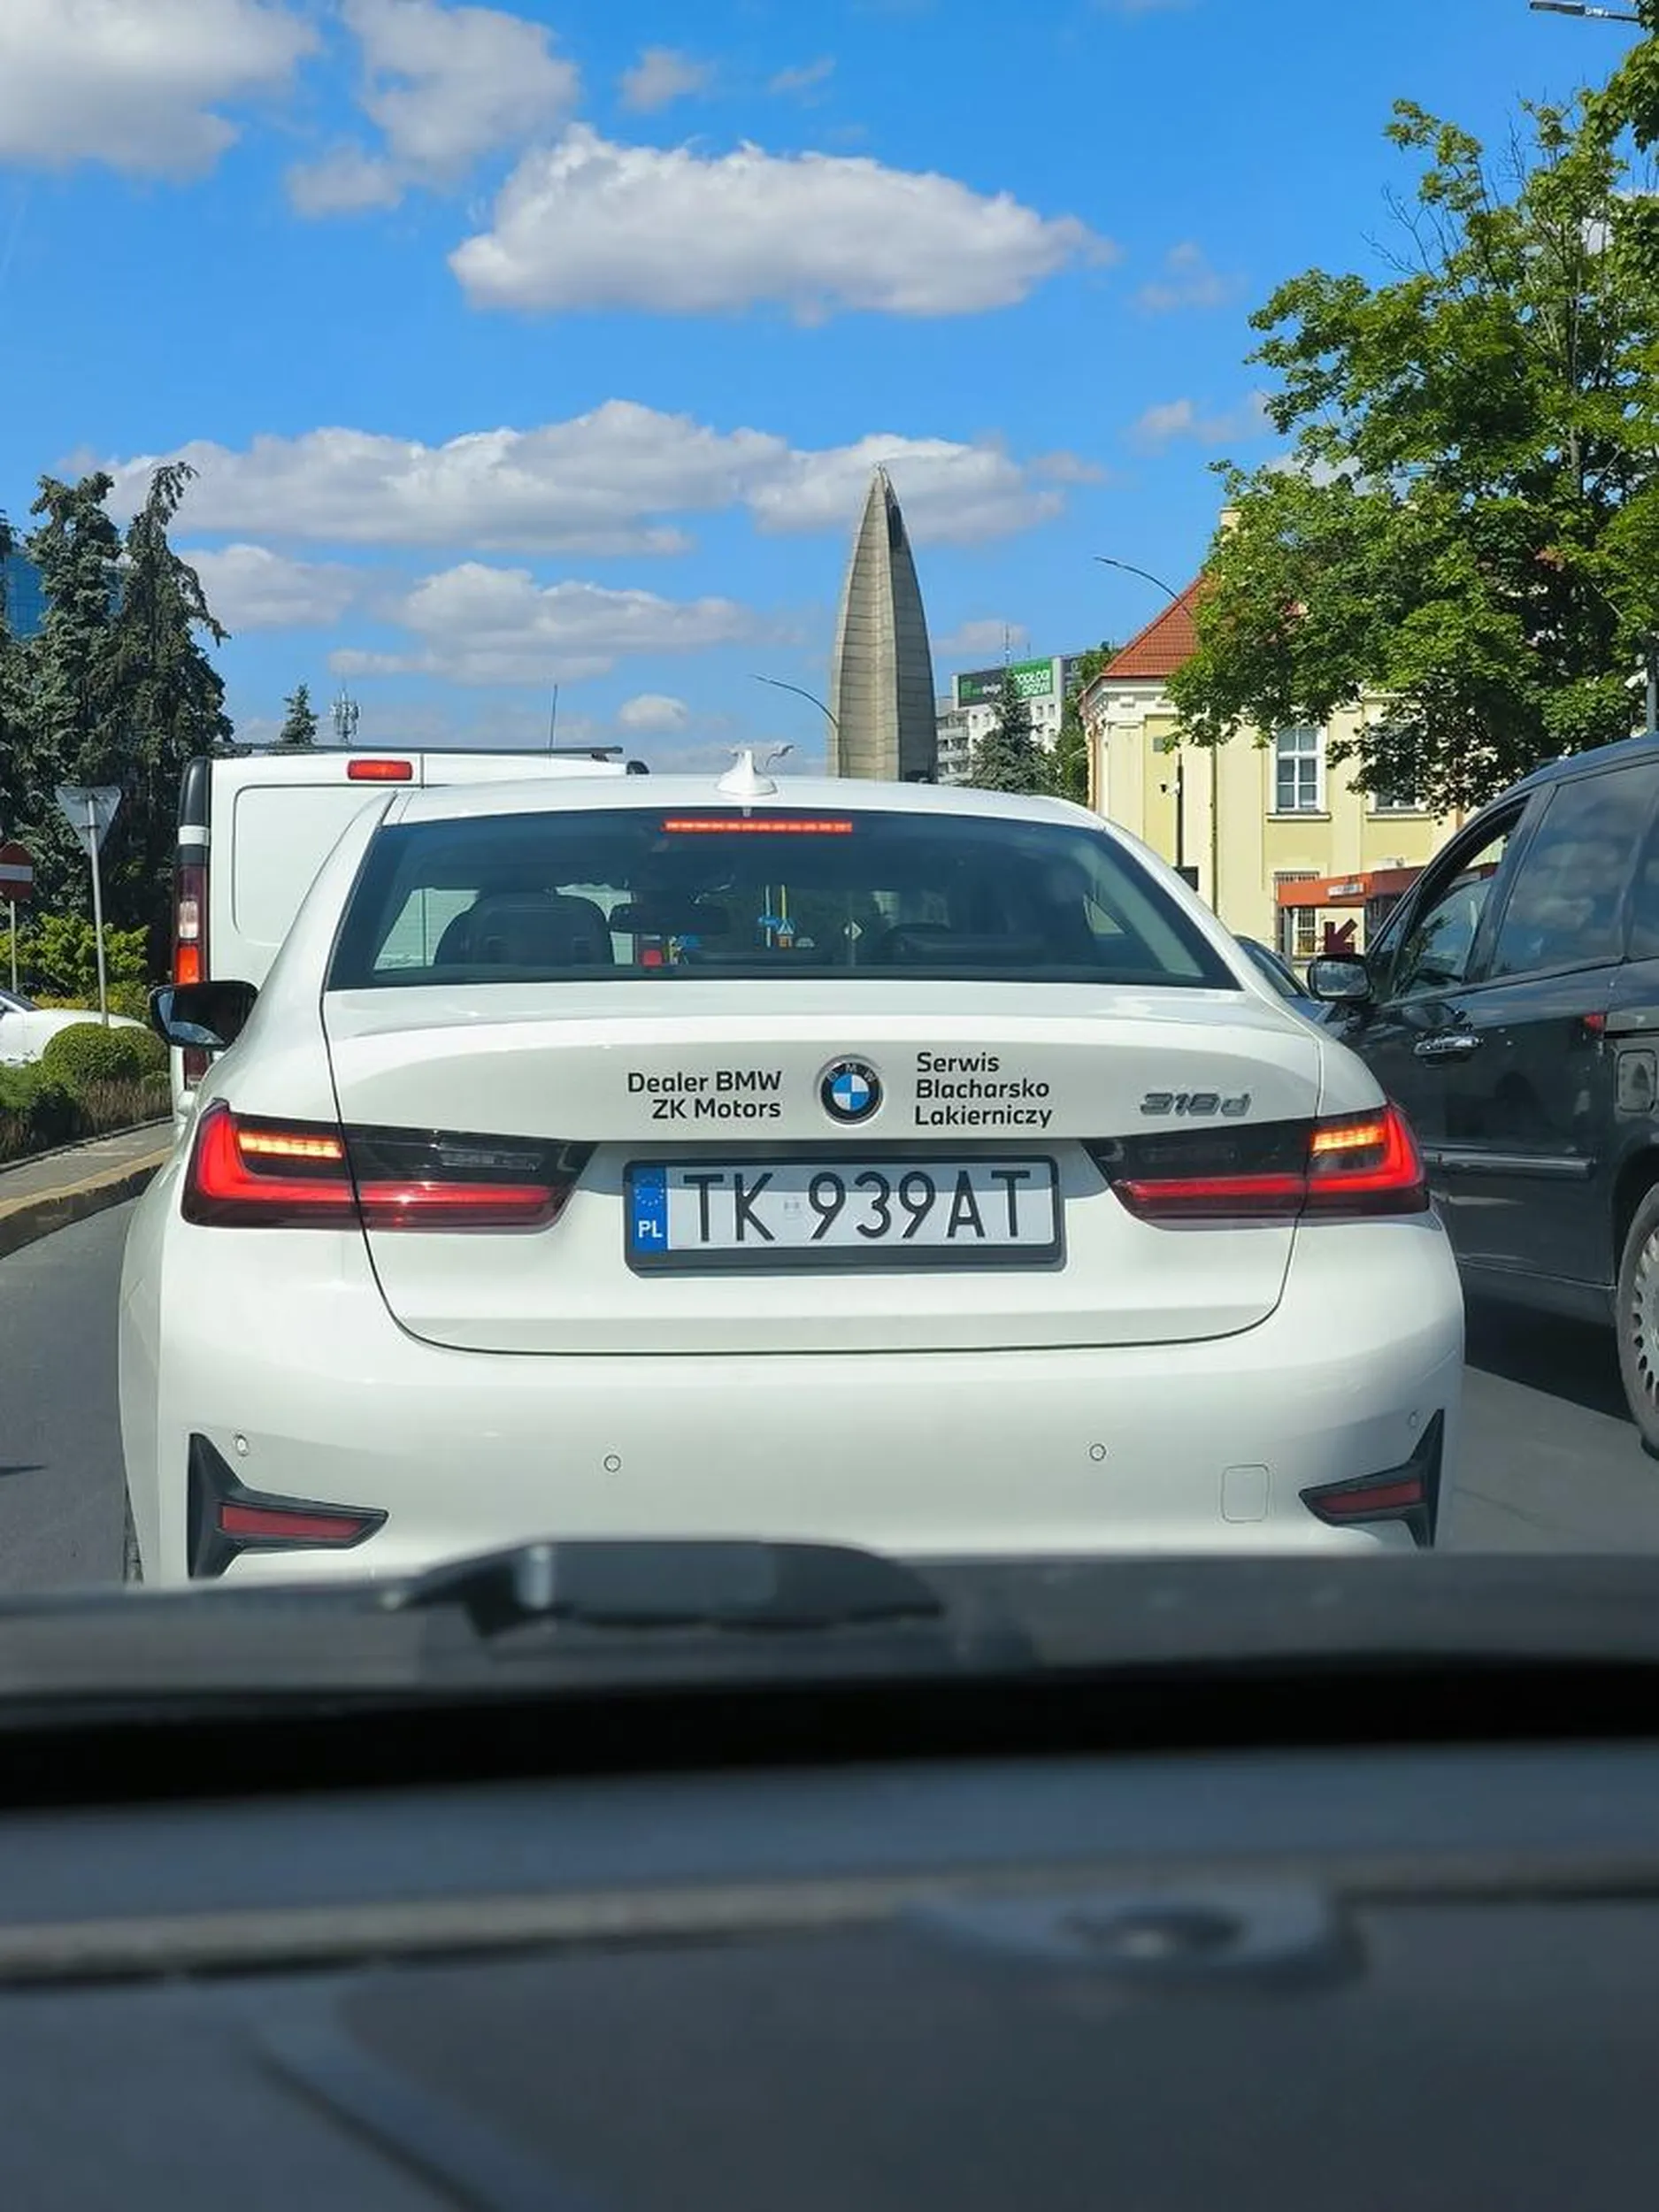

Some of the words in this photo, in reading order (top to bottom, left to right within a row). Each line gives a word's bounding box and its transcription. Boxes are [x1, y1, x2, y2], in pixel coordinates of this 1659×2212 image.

[917, 1052, 1000, 1072] Serwis
[628, 1071, 708, 1093] Dealer
[716, 1071, 781, 1091] BMW
[917, 1078, 1049, 1099] Blacharsko
[652, 1098, 687, 1119] ZK
[694, 1098, 781, 1118] Motors
[1141, 1093, 1250, 1117] 318d
[915, 1104, 1052, 1128] Lakierniczy
[683, 1172, 775, 1242] TK
[809, 1170, 1031, 1240] 939AT
[638, 1220, 663, 1239] PL
